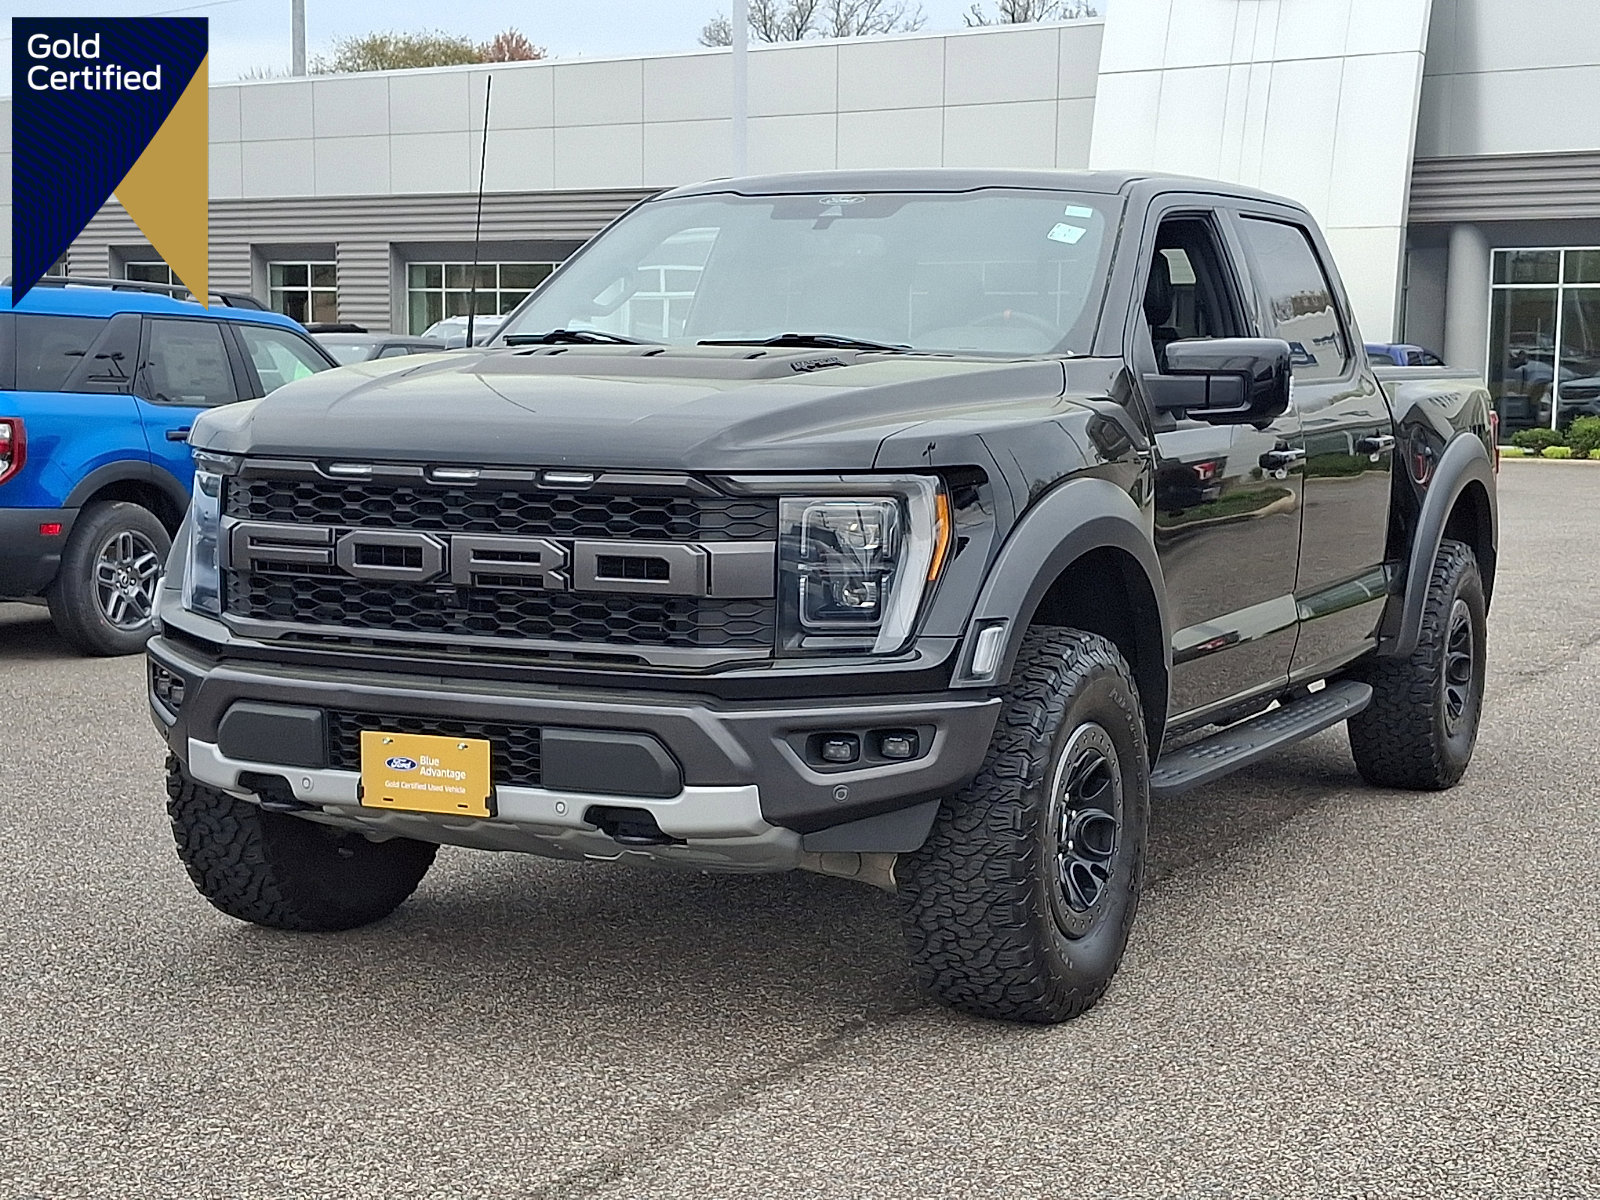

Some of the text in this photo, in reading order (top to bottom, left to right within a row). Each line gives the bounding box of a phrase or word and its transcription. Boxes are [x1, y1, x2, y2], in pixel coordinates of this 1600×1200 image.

[232, 519, 707, 598] FORD
[420, 755, 440, 766] Blue
[420, 767, 466, 780] Advantage
[385, 780, 466, 794] Gold Certified Used Vehicle
